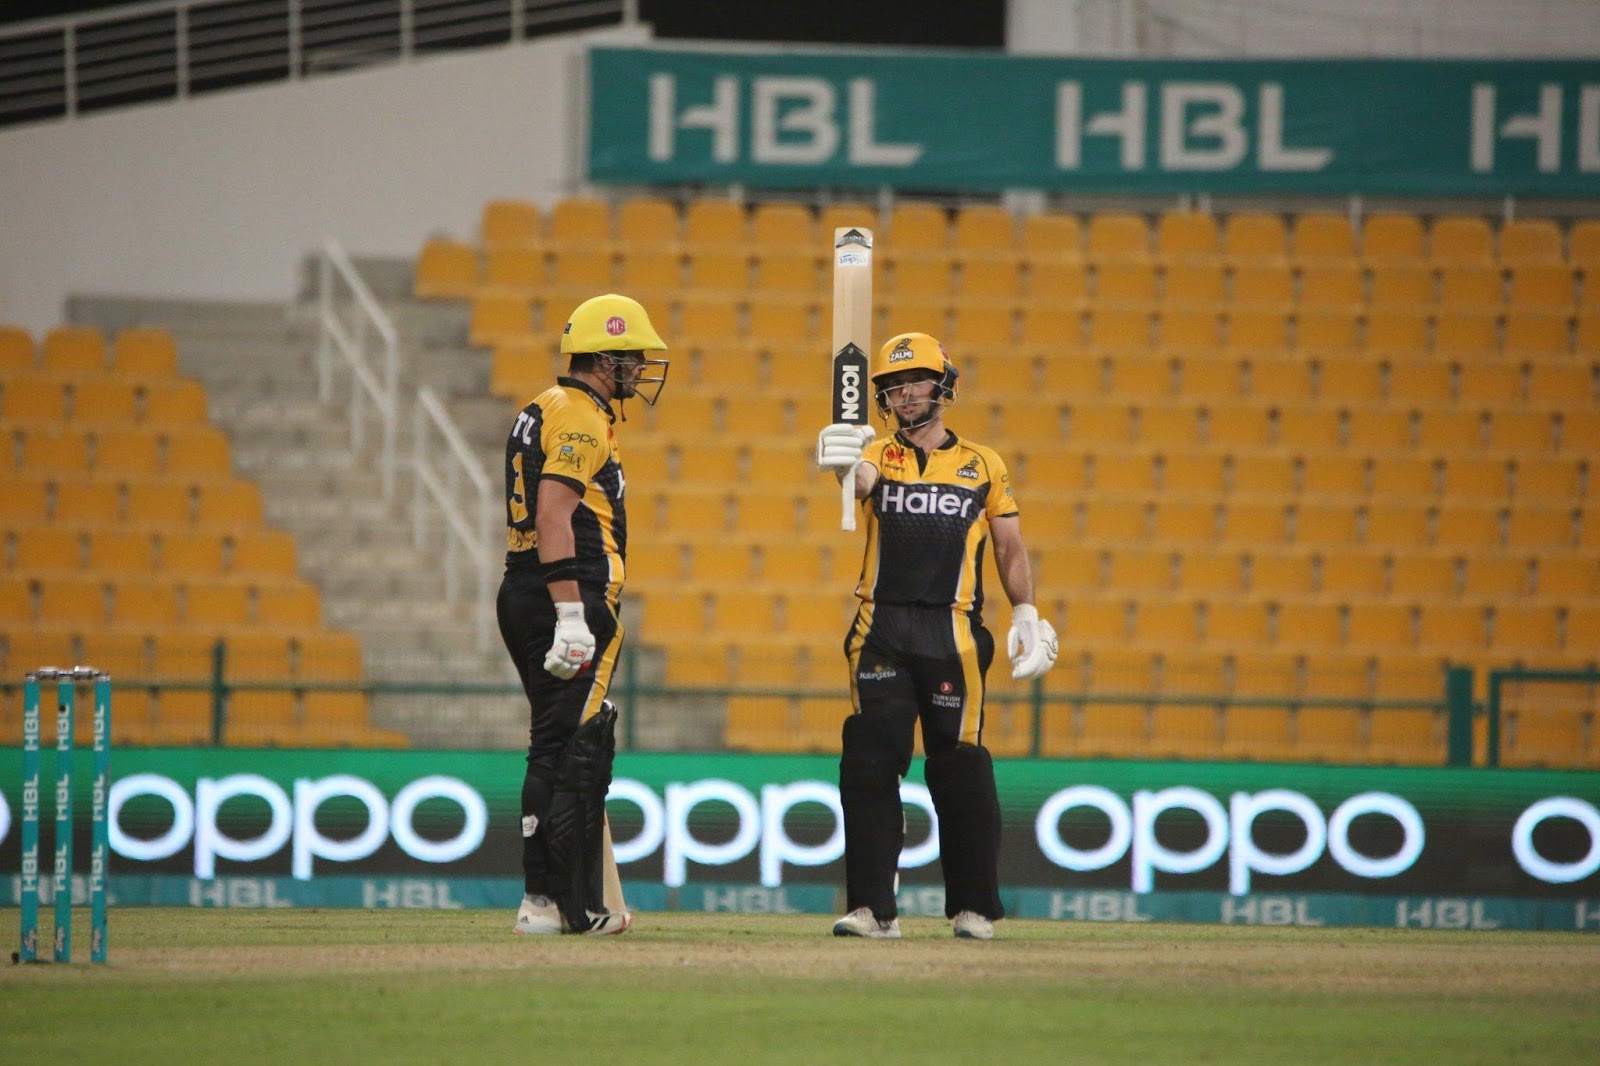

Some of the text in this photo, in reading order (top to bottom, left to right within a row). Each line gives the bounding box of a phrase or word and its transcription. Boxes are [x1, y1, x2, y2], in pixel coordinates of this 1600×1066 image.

[648, 74, 924, 166] HBL
[1055, 81, 1335, 172] HBL
[606, 317, 626, 335] MG
[889, 350, 913, 363] ZALMI
[841, 365, 860, 420] ICON
[559, 432, 598, 448] oppo
[957, 469, 979, 480] ZALMI
[881, 484, 973, 518] Haier
[932, 693, 961, 702] TURKISH
[932, 699, 960, 708] AIRLINES
[24, 704, 39, 751] HBL
[57, 704, 70, 751] HBL
[23, 773, 39, 822] HBL
[56, 773, 69, 821] HBL
[107, 772, 488, 881] oppo
[1035, 783, 1425, 896] oppo
[22, 843, 39, 892] HBL
[54, 842, 67, 892] HBL
[189, 880, 293, 909] HBL
[362, 880, 465, 909] HBL
[703, 886, 802, 914] HBL
[1049, 890, 1153, 922] HBL
[1220, 894, 1323, 926] HBL
[1396, 898, 1499, 929] HBL
